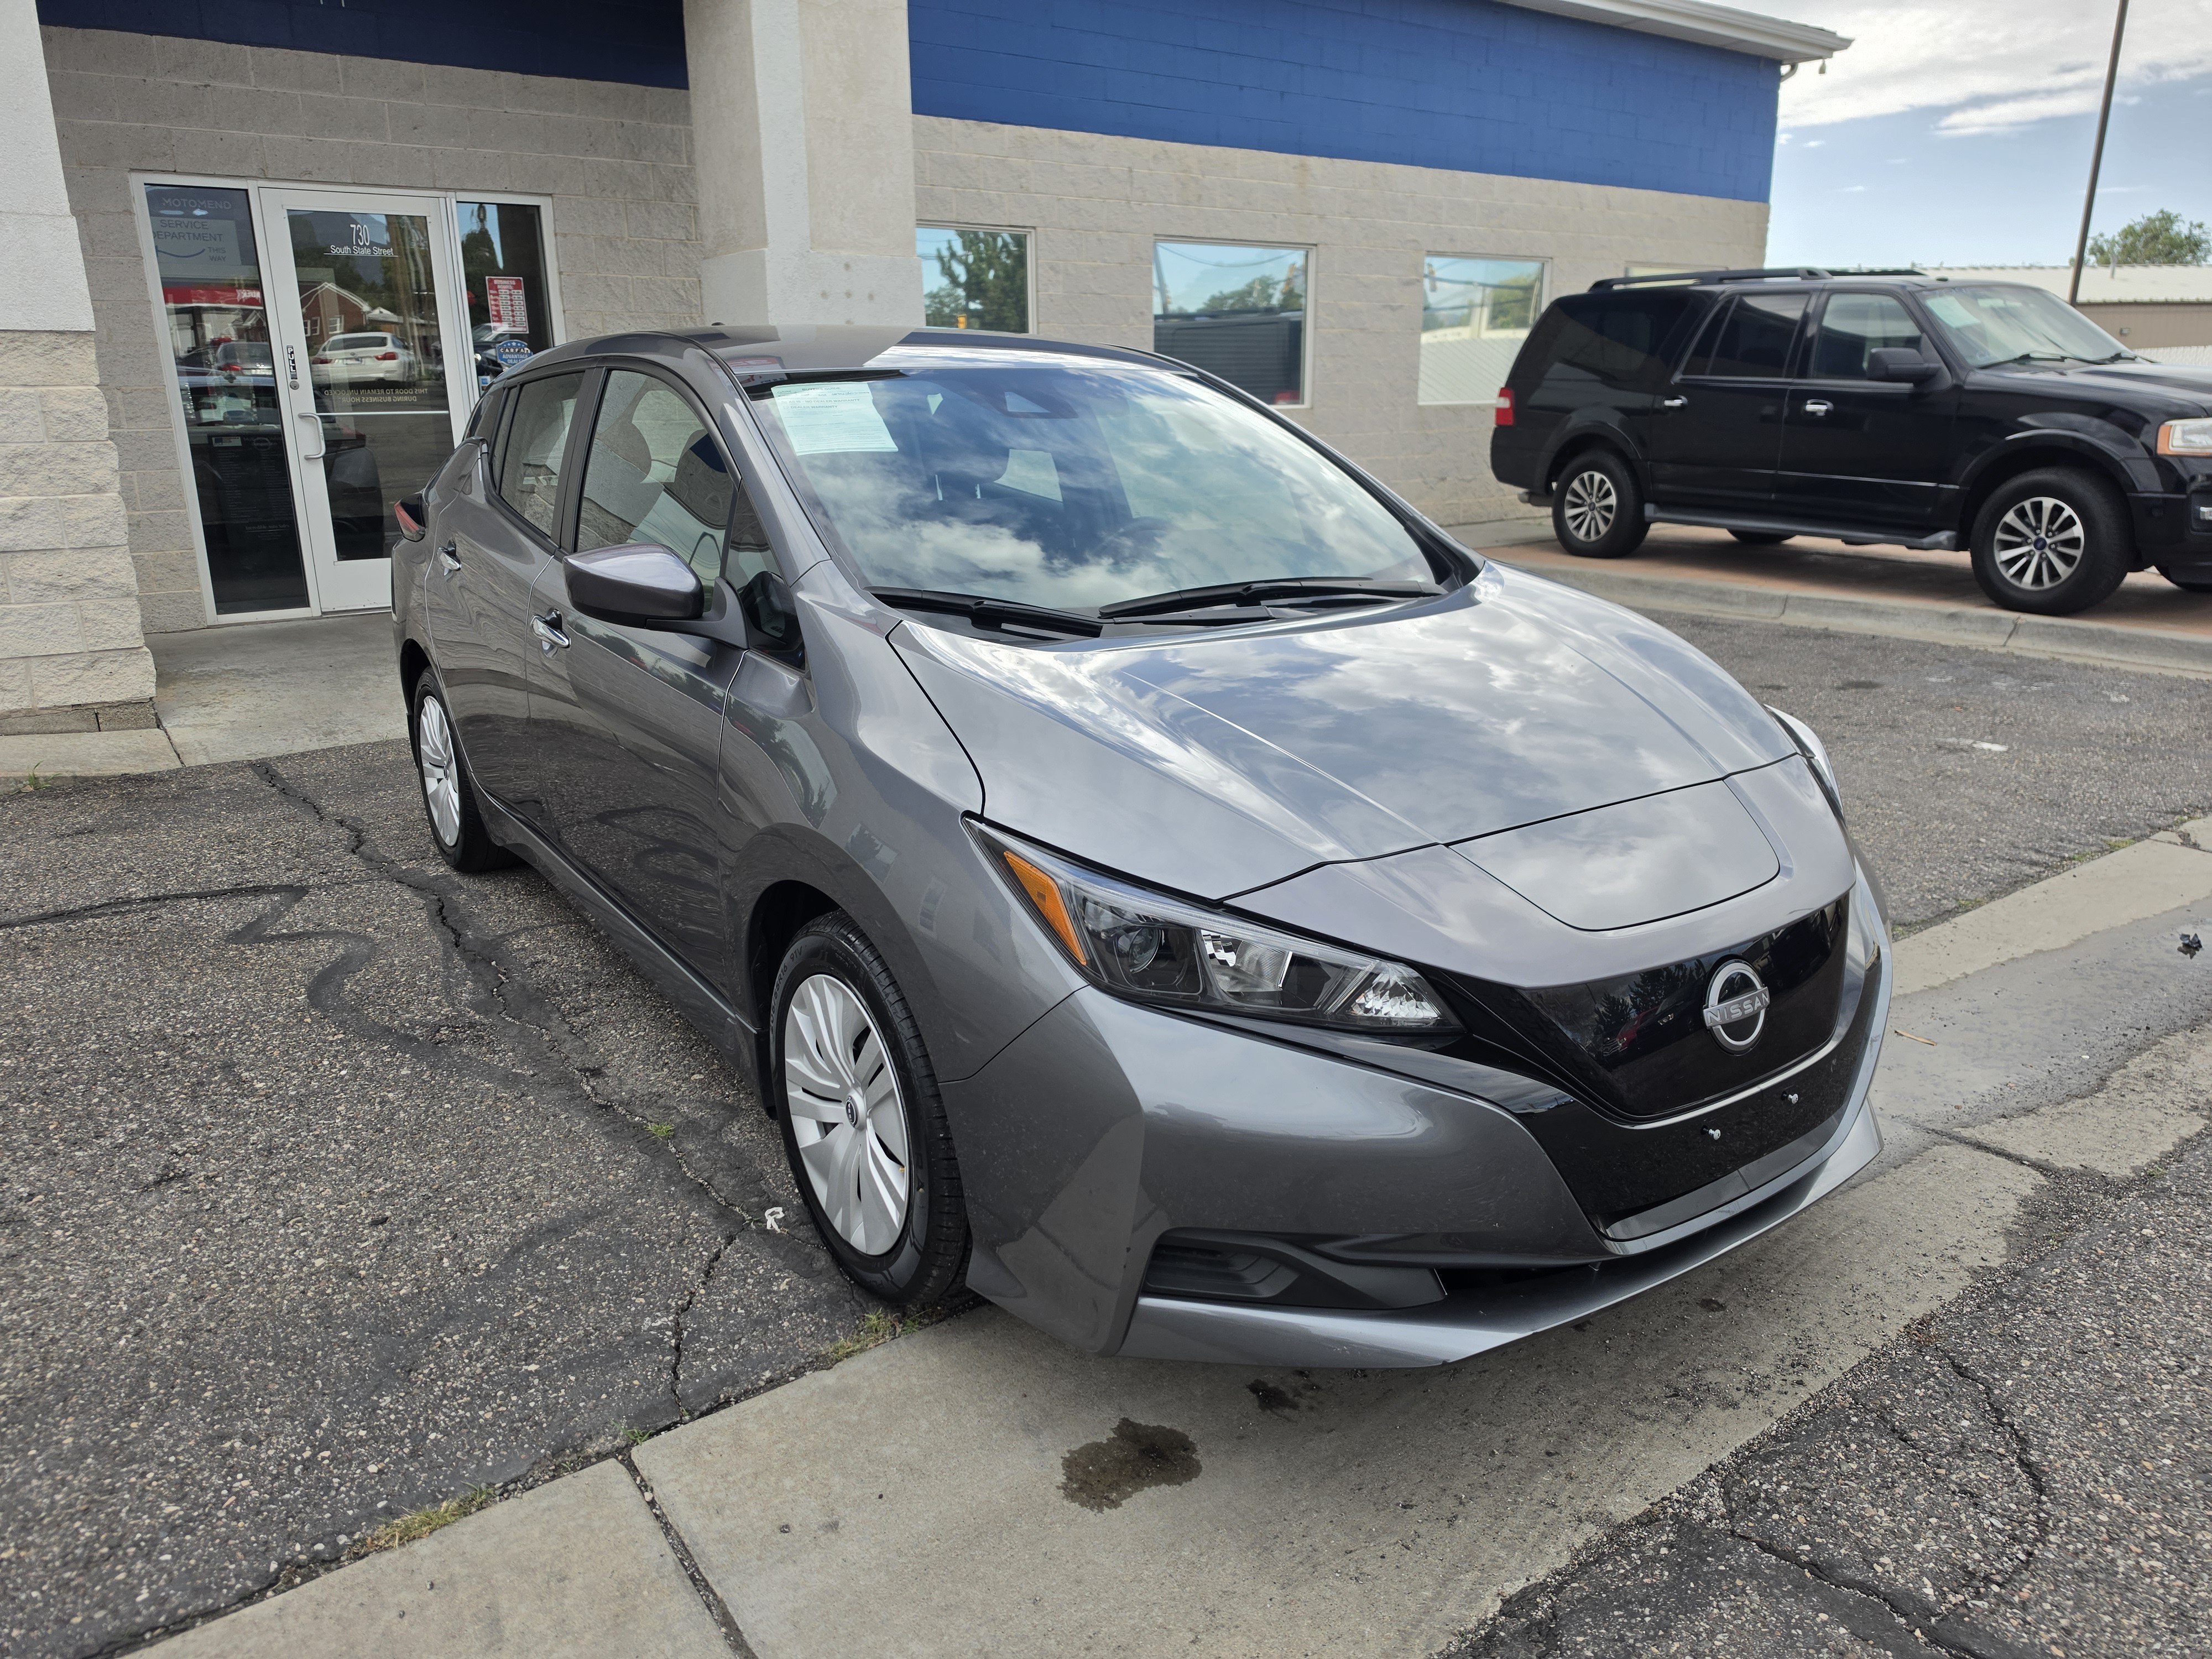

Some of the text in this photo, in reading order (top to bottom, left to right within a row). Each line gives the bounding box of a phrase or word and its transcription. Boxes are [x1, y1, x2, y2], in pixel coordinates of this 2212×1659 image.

[163, 197, 232, 210] MOTOMEND
[160, 220, 209, 230] SERVICE
[349, 224, 371, 246] 730
[330, 244, 394, 255] South State Street
[288, 348, 296, 372] PULL
[1708, 992, 1770, 1025] NISSAN
